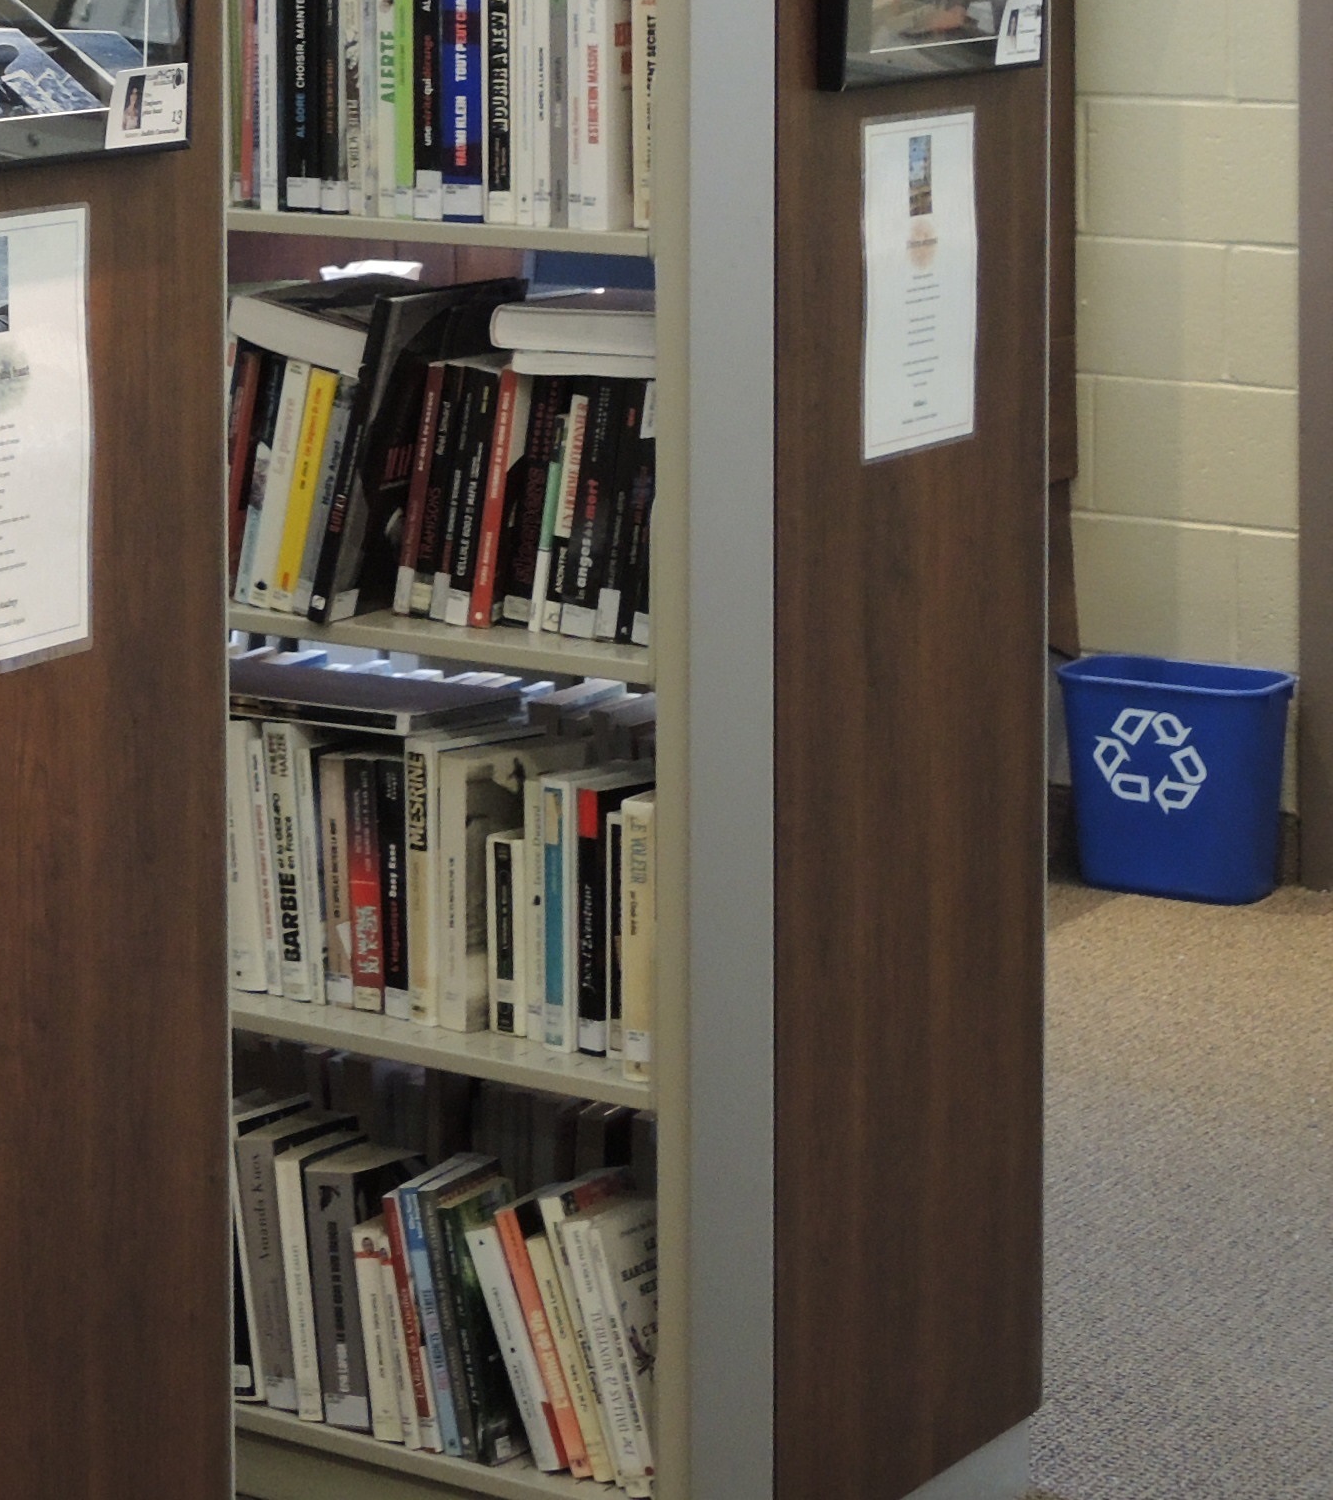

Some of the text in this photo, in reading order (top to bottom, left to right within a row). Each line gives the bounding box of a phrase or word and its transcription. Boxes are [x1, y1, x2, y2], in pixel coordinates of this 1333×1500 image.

[422, 0, 432, 12] AL
[455, 22, 468, 52] PEUT
[295, 40, 308, 88] CHOISIR,
[455, 53, 468, 81] TOUT
[296, 92, 306, 122] GORE
[587, 44, 599, 144] DESTRUCTION MASSIVE
[296, 124, 306, 138] AL
[455, 95, 468, 166] NAOMI KLEIN
[407, 751, 427, 852] MESRINE
[278, 872, 302, 962] BARBIE
